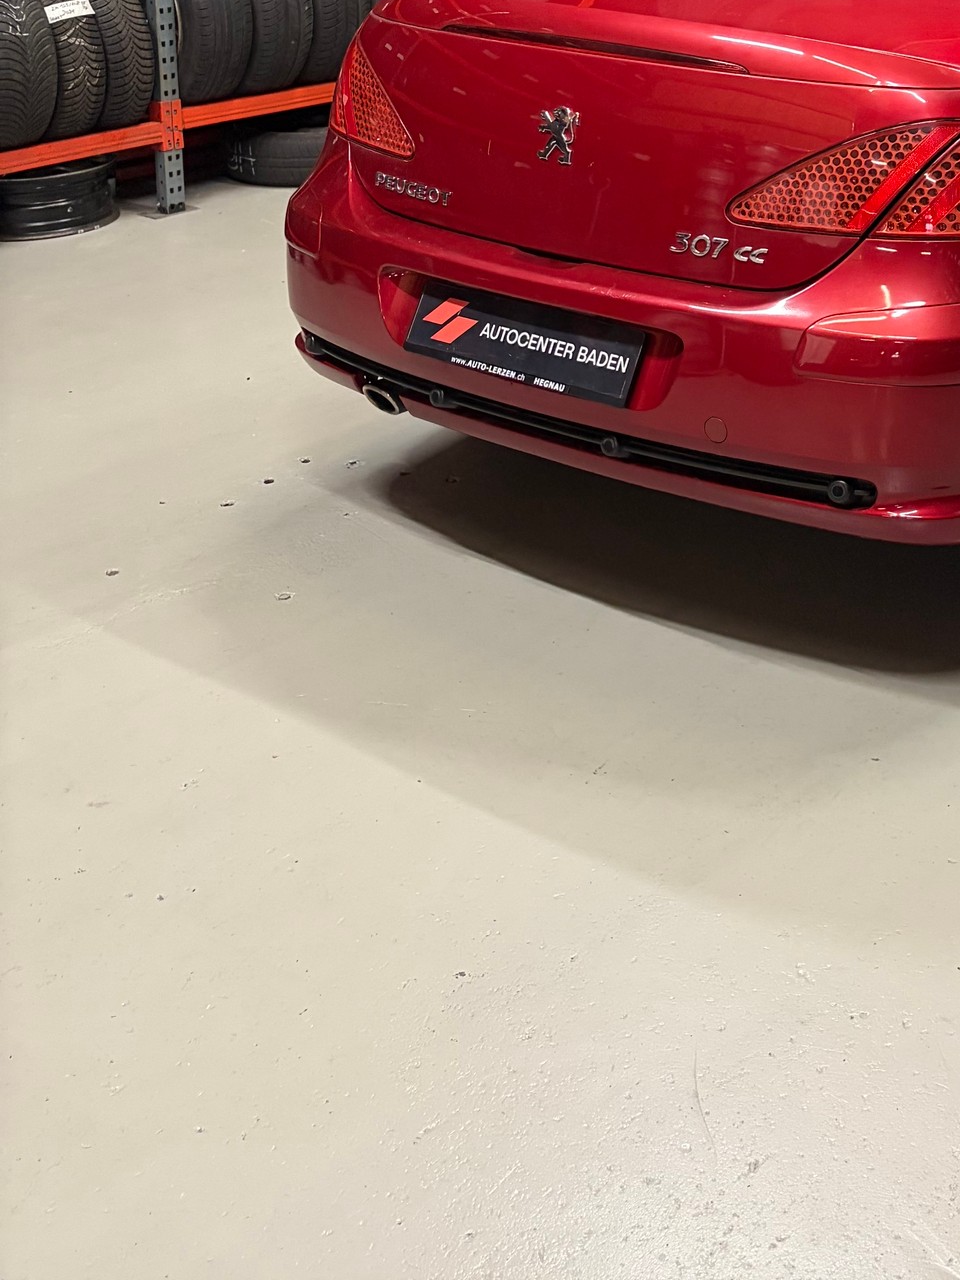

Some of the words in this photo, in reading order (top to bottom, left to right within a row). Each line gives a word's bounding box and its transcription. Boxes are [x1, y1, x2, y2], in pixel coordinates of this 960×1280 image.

[374, 170, 454, 207] PEUGEOT
[669, 231, 729, 259] 307
[479, 322, 575, 360] AUTOCENTER
[576, 346, 630, 374] BADEN
[533, 376, 566, 393] HEGNAU
